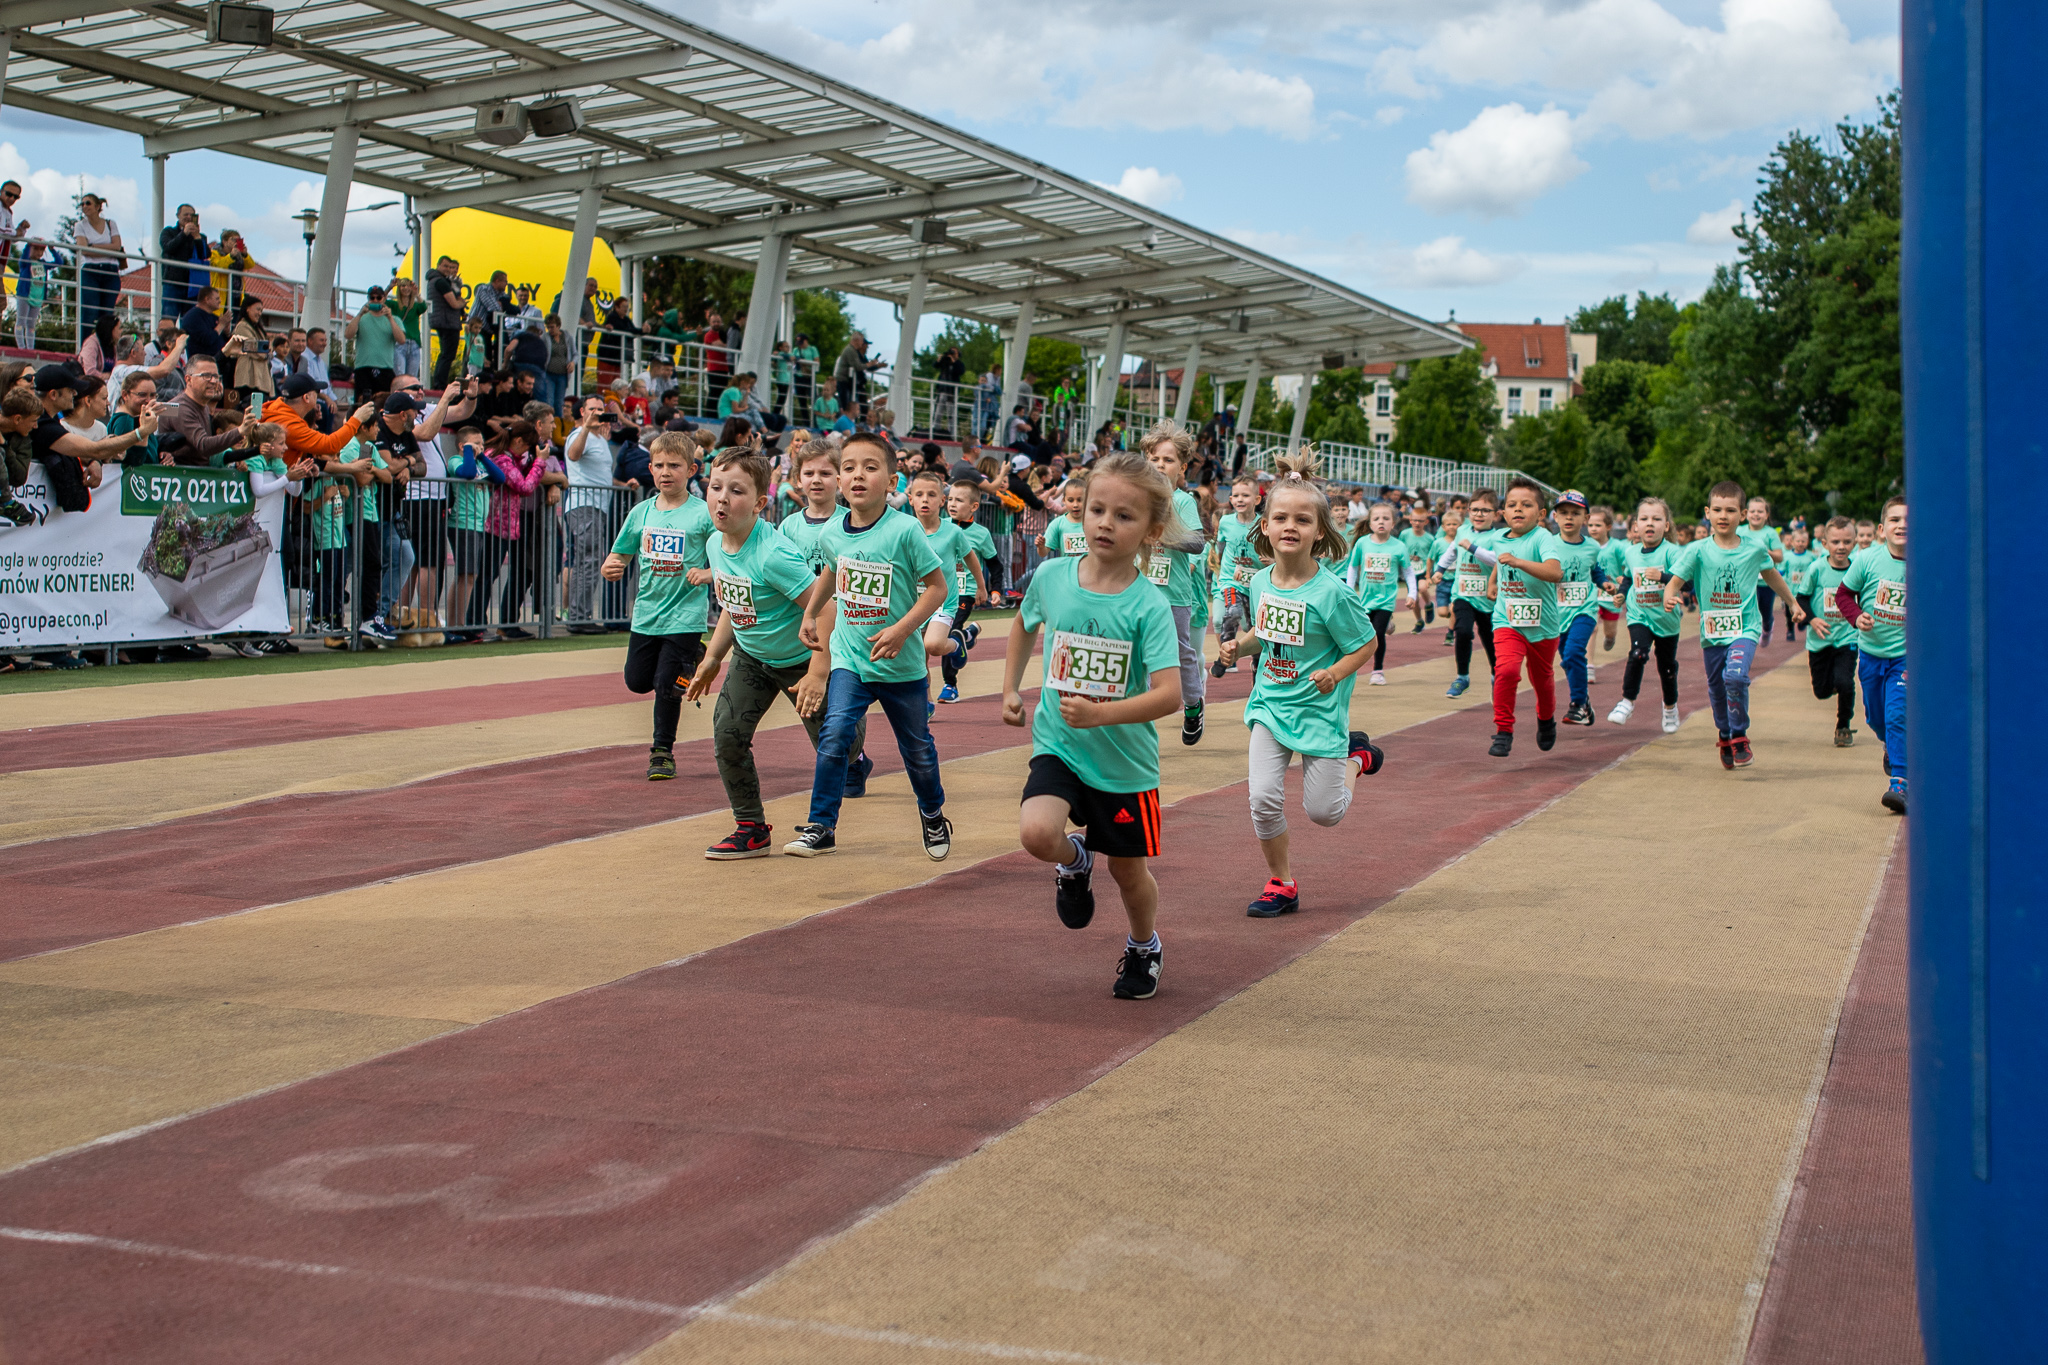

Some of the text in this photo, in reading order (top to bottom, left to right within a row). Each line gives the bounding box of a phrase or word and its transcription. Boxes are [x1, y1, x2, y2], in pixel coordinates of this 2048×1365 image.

[151, 477, 248, 504] 572 021 121
[655, 536, 680, 553] 821
[28, 556, 39, 567] w
[42, 552, 104, 571] ogrodzie?
[1372, 558, 1388, 567] 325
[44, 573, 134, 593] KONTENER!
[851, 571, 885, 595] 273
[1466, 581, 1484, 591] 338
[723, 582, 749, 606] 332
[1565, 588, 1586, 600] 358
[844, 608, 888, 618] PAPIESKI
[1267, 607, 1300, 633] 333
[1514, 605, 1539, 619] 363
[1715, 616, 1740, 631] 293
[1085, 638, 1099, 646] BIEG
[1072, 649, 1123, 682] 355
[1272, 658, 1296, 669] BIEG
